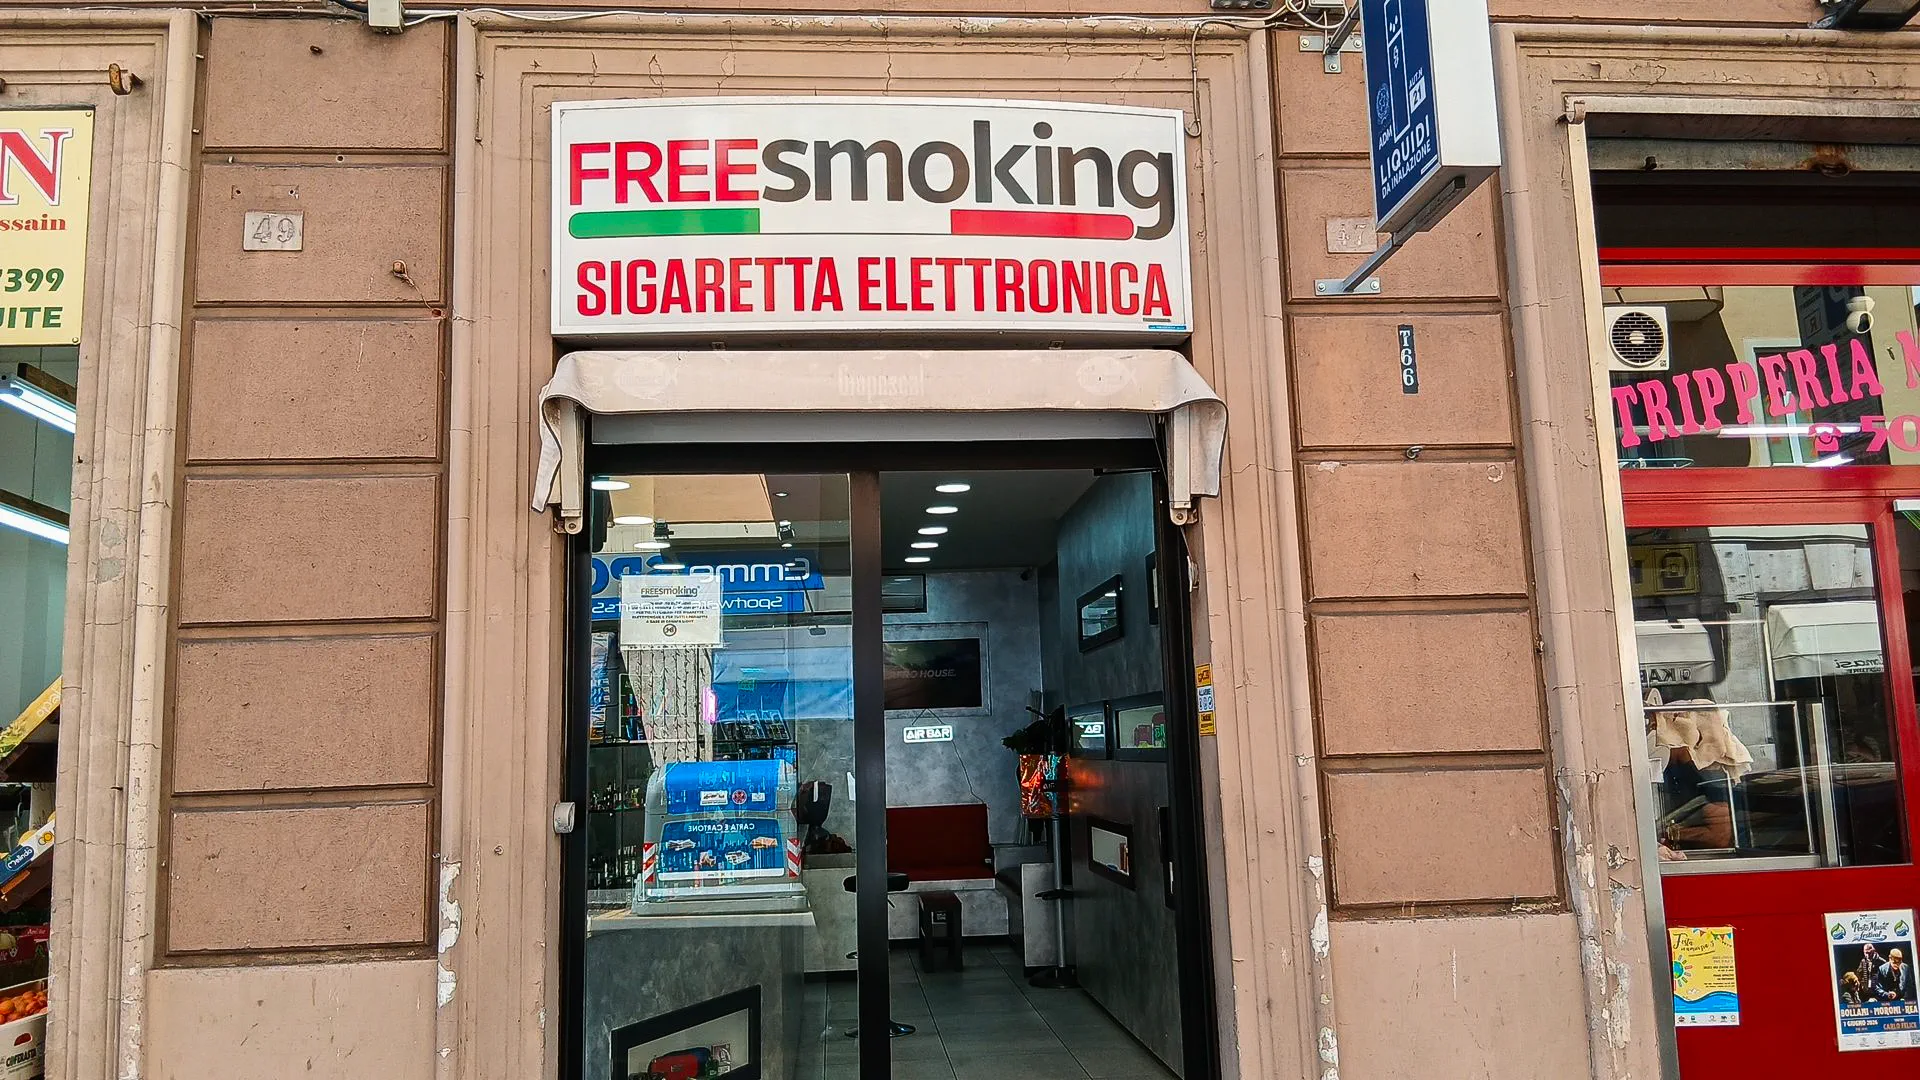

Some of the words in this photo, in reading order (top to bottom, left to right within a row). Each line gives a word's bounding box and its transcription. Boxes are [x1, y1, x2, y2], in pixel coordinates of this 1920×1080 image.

[1378, 124, 1393, 150] ADM
[1380, 114, 1431, 186] LIQUIDI
[569, 119, 1175, 241] FREEsmoking
[1382, 183, 1392, 200] DA
[1391, 138, 1432, 190] INALAZIONE
[253, 214, 295, 243] 49
[0, 268, 65, 293] 399
[576, 257, 844, 318] SIGARETTA
[857, 256, 1173, 318] ELETTRONICA
[1399, 329, 1415, 387] T66
[1611, 338, 1885, 448] TRIPPERIA
[906, 729, 925, 741] AIR
[926, 728, 950, 739] BAR
[1840, 1007, 1869, 1018] BOLLANI
[1873, 1005, 1901, 1016] MORONI
[1904, 1005, 1919, 1015] REA
